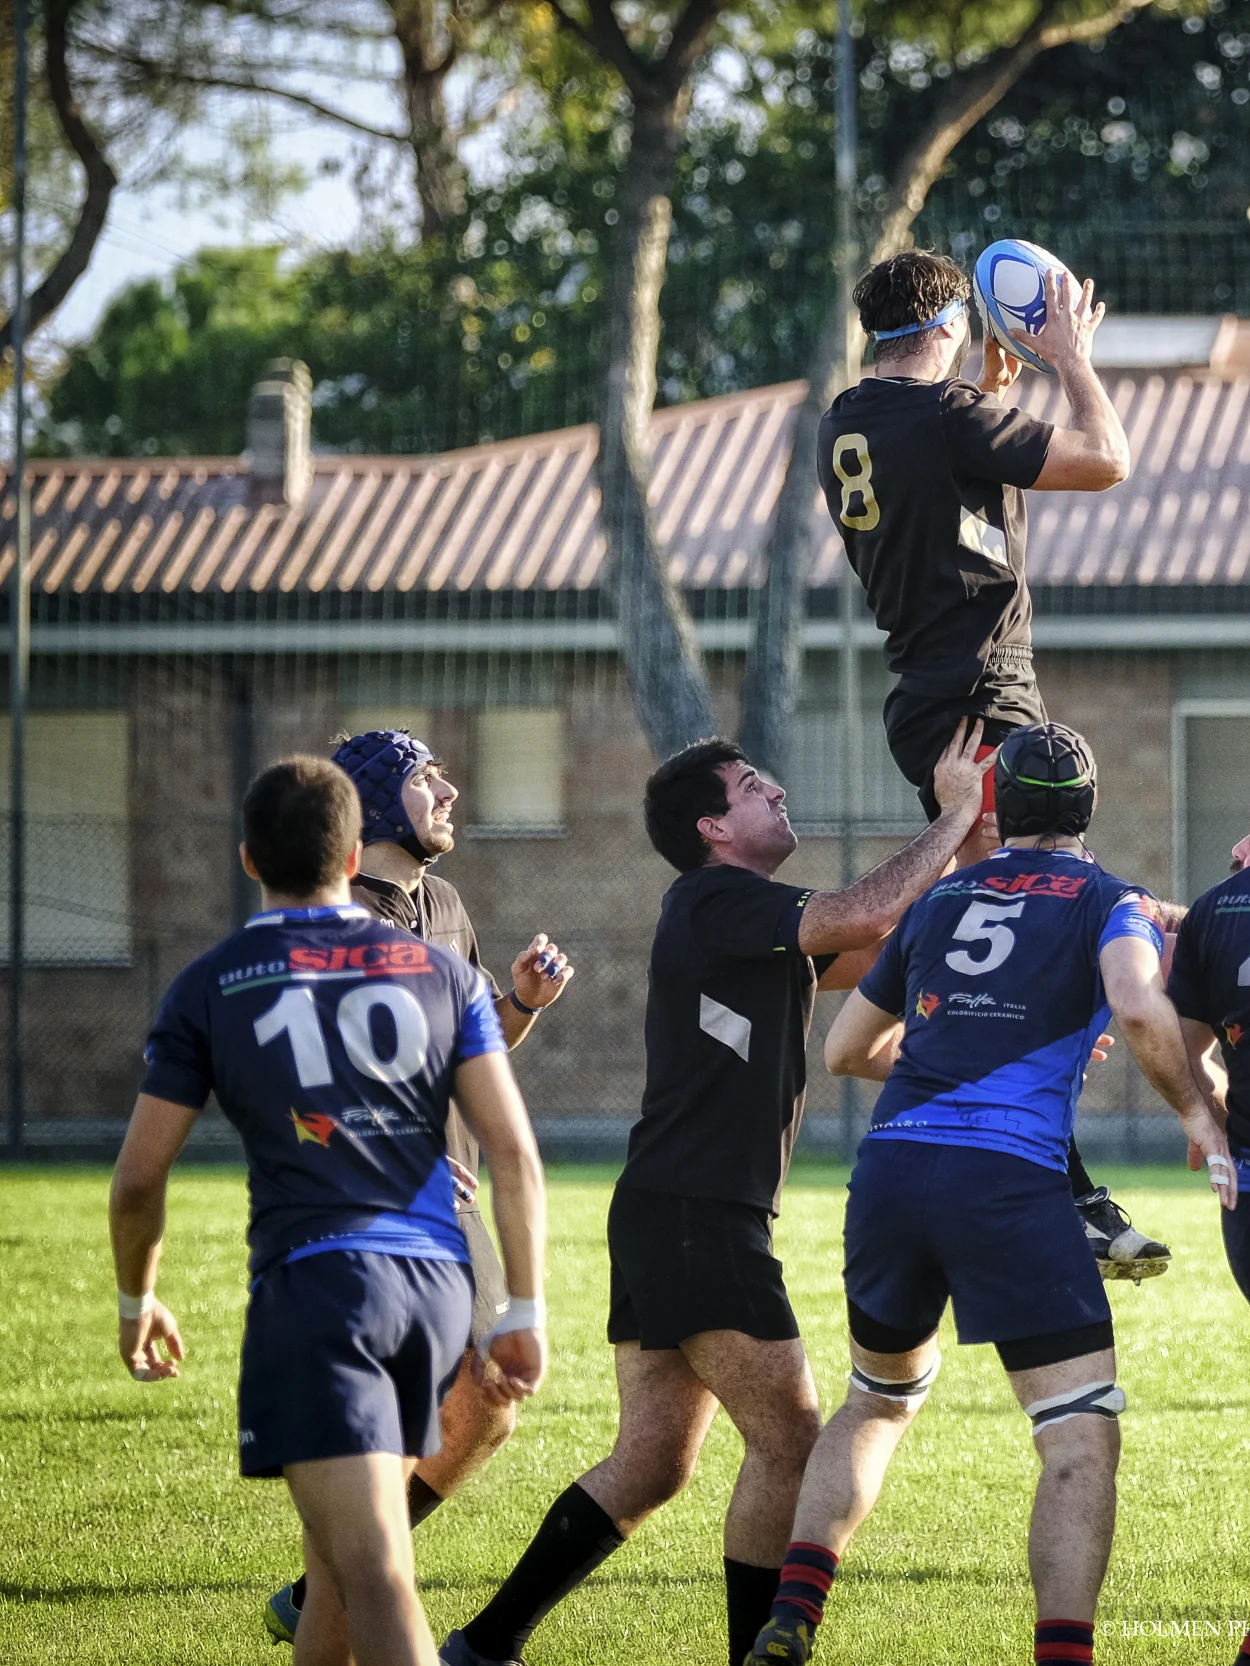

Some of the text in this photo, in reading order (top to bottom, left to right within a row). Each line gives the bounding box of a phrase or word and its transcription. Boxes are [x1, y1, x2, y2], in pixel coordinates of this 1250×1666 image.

[833, 433, 880, 531] 8
[945, 900, 1025, 976] 5
[253, 982, 428, 1089] 10
[989, 1012, 1025, 1020] CERAMICO
